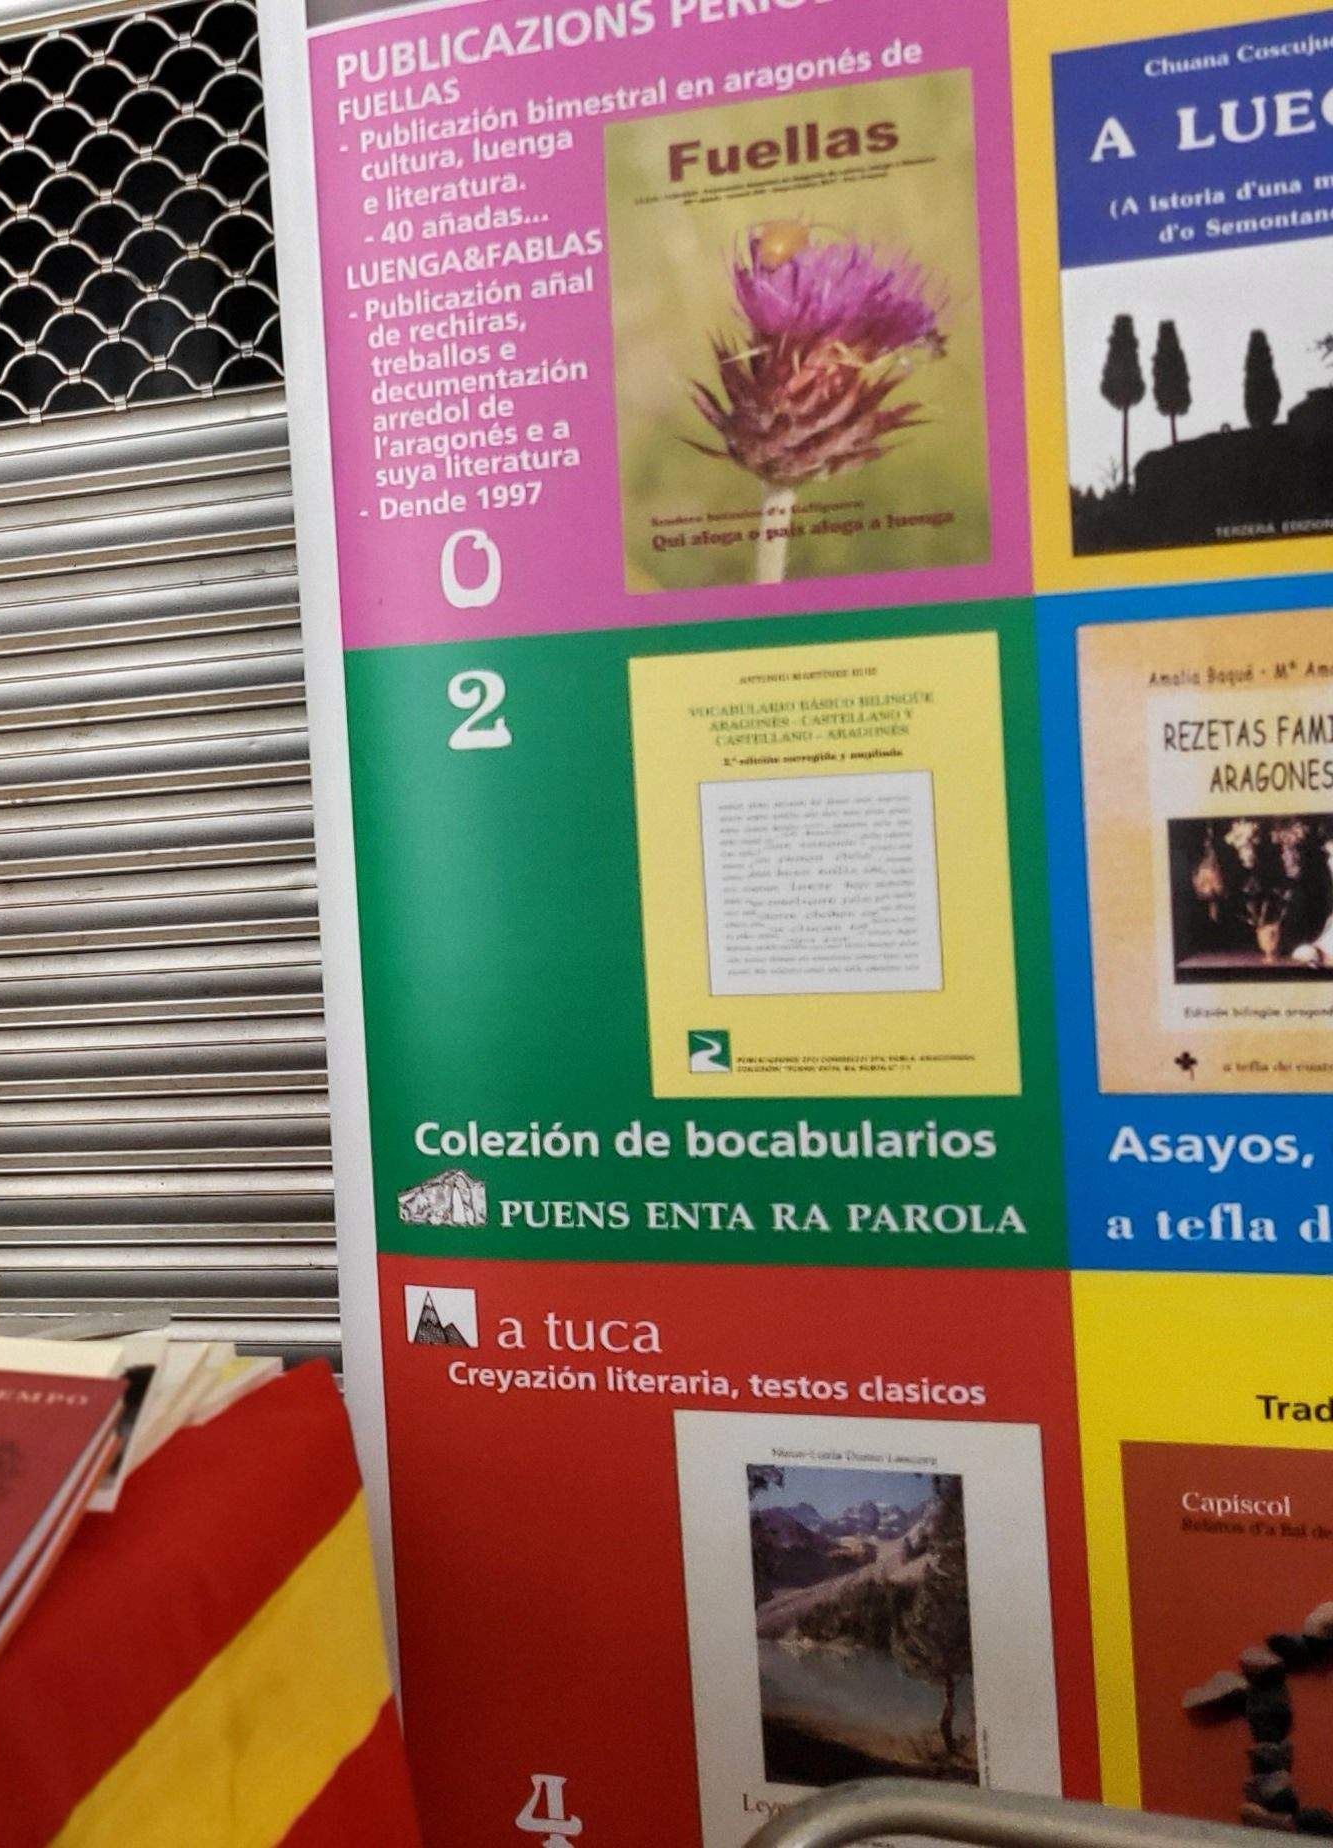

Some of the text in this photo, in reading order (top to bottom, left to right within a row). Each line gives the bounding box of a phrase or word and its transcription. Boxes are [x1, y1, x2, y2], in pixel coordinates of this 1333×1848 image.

[336, 0, 656, 90] PUBLICAZIONS
[1143, 34, 1333, 78] Chuana Coscuju
[338, 77, 461, 125] FUELLAS
[359, 37, 924, 154] Publicazión bimestral en aragonés de
[1089, 86, 1333, 163] A LUE
[360, 128, 574, 182] cultura, luenga
[667, 120, 900, 184] Fuellas
[362, 172, 527, 216] e literatura.
[1109, 196, 1139, 221] (A
[1149, 188, 1226, 213] istoria
[1235, 177, 1303, 202] d'una
[380, 204, 550, 245] 40 añadas...
[1158, 207, 1333, 244] d'o Semontan
[345, 227, 604, 291] LUENGA&FABLAS
[364, 265, 594, 322] Publicazión añal
[367, 309, 527, 350] de rechiras,
[370, 340, 517, 379] treballos e
[371, 356, 589, 406] decumentazión
[372, 393, 515, 433] arredol de
[373, 419, 571, 460] l'aragonés e a
[374, 445, 581, 491] suya literatura
[378, 480, 544, 521] Dende 1997
[446, 668, 513, 750] 2
[1163, 718, 1267, 752] REZETAS
[413, 1120, 998, 1160] Colezión de bocabularios
[1107, 1125, 1316, 1174] Asayos,
[499, 1199, 1028, 1235] PUENS ENTA RA PAROLA
[1106, 1215, 1135, 1241] a
[1155, 1202, 1279, 1243] tefla
[495, 1310, 663, 1354] a tuca
[447, 1359, 987, 1406] Creyazión literaria, testos clasicos
